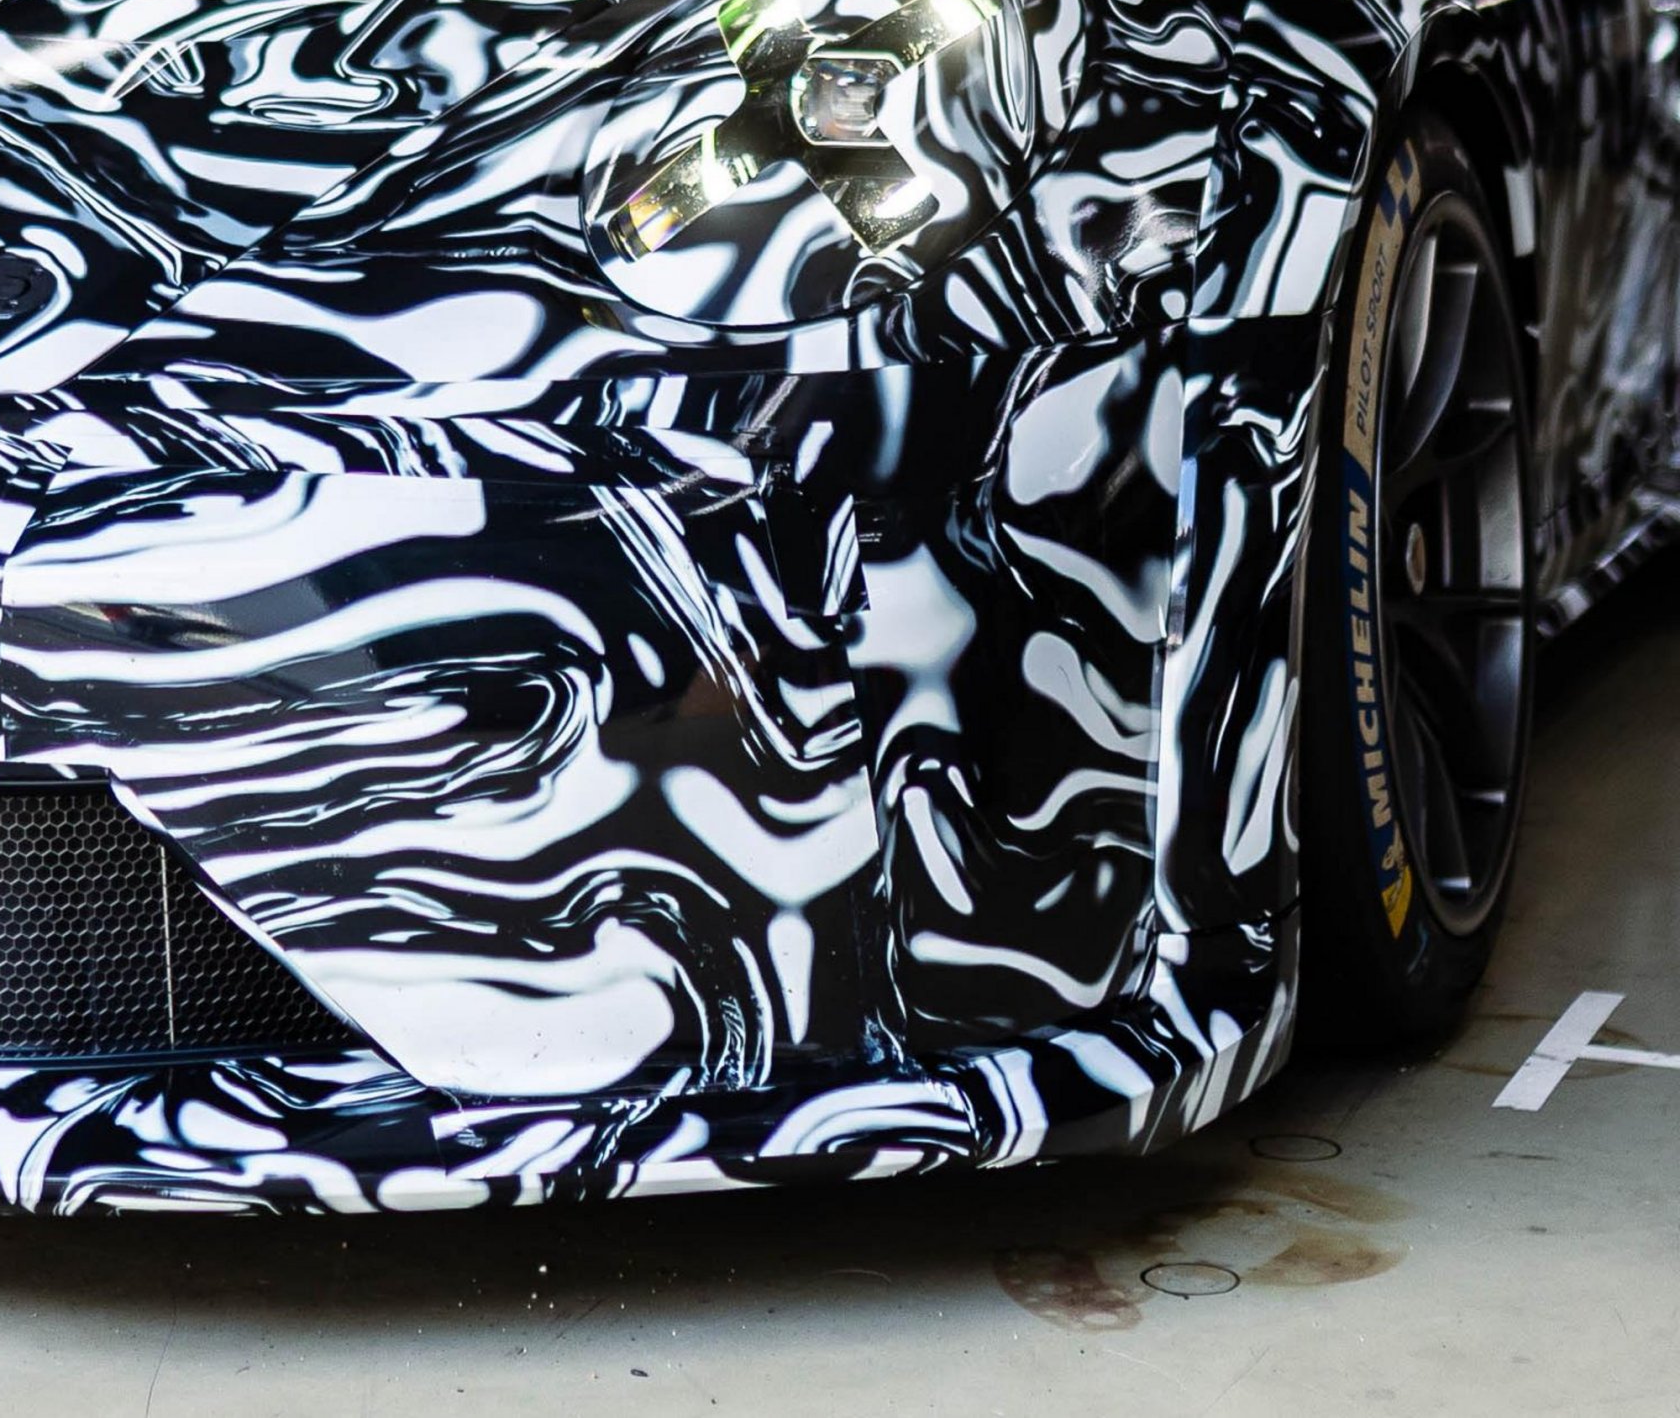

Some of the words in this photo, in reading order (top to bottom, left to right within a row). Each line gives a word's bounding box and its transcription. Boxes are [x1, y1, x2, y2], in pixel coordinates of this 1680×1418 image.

[1356, 338, 1374, 437] PILOT
[1366, 242, 1388, 339] SPORT
[1349, 488, 1392, 829] MICHELIN
